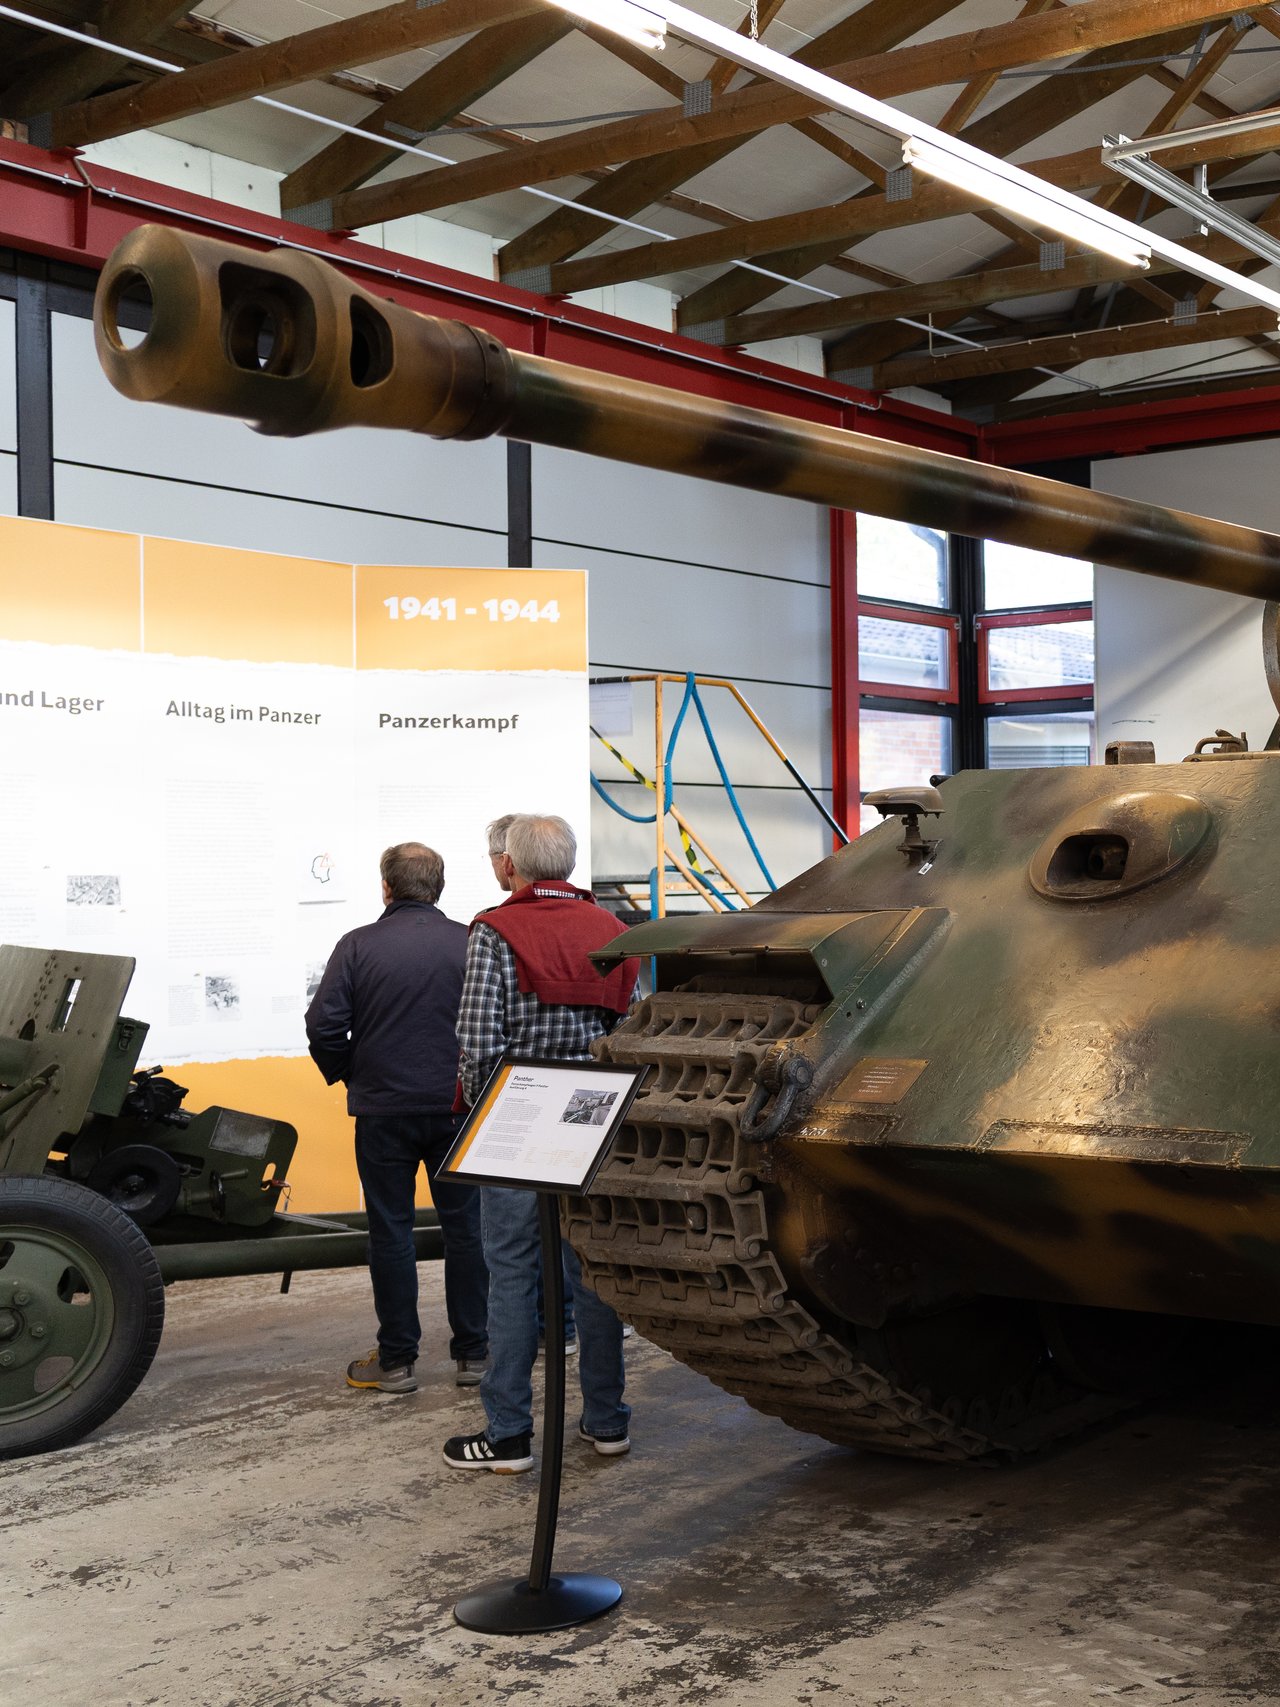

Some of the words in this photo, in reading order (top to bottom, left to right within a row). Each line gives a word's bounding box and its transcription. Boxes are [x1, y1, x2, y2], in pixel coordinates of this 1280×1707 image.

[383, 596, 457, 621] 1941
[483, 598, 561, 623] 1944
[41, 691, 105, 715] Lager
[165, 700, 226, 724] Alltag
[230, 703, 254, 721] im
[258, 705, 322, 726] Panzer
[378, 712, 520, 734] Panzerkampf
